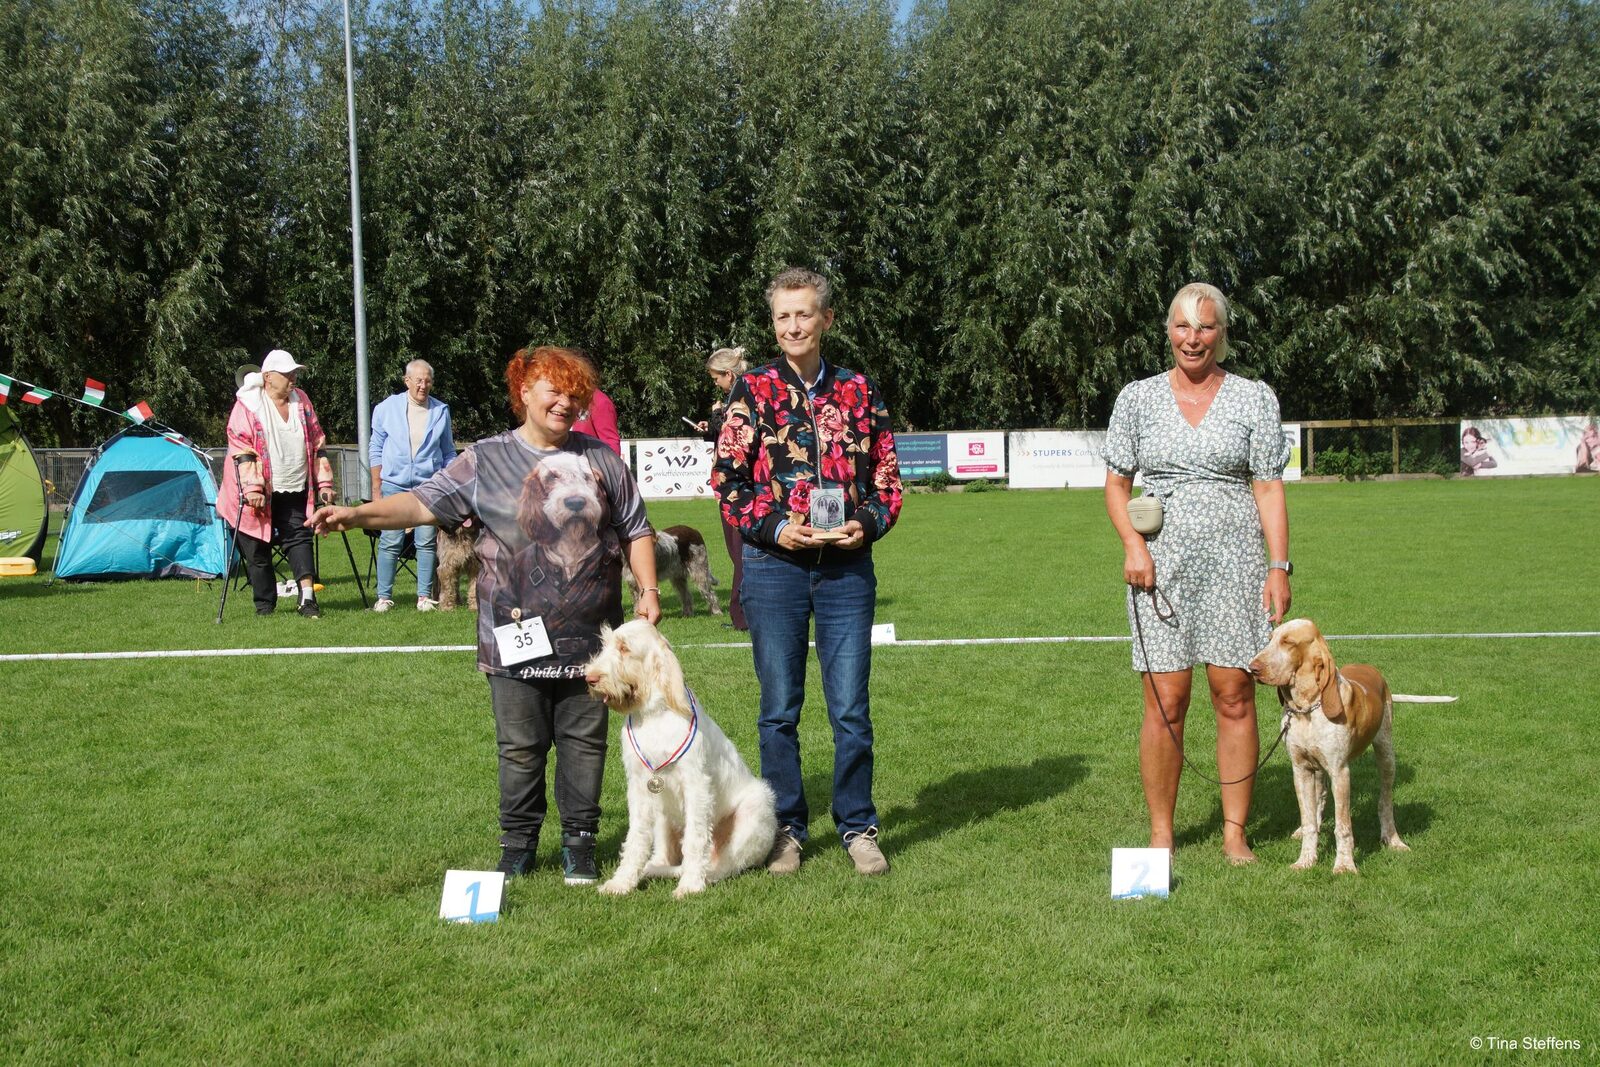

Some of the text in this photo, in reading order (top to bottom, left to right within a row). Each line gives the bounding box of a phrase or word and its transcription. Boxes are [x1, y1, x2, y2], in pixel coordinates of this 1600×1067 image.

[1033, 449, 1072, 457] STUPERS
[514, 632, 533, 649] 35
[1130, 861, 1151, 893] 2
[465, 881, 481, 919] 1
